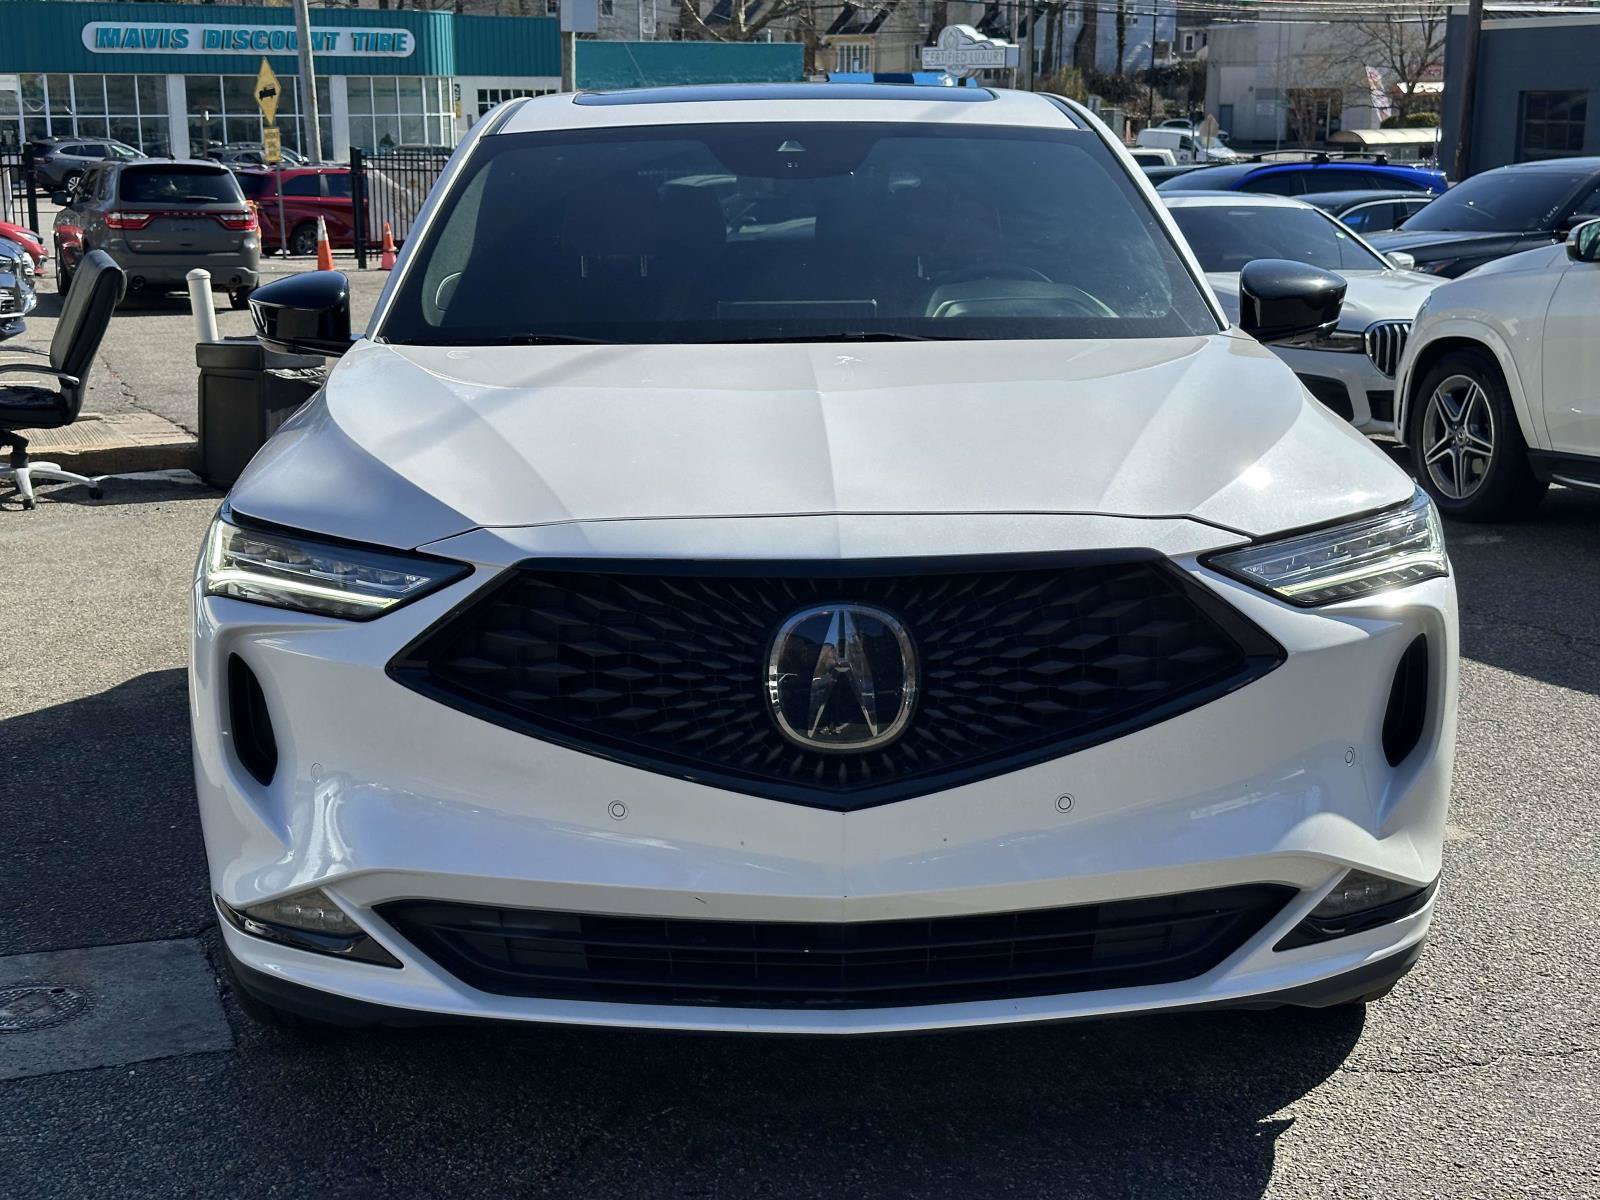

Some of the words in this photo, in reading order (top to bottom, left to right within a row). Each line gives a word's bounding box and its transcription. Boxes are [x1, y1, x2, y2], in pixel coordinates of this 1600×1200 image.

[96, 27, 190, 49] MAVIS
[351, 32, 408, 52] TIRE
[924, 51, 967, 64] CERTIFIED
[968, 51, 1004, 64] LUXURY
